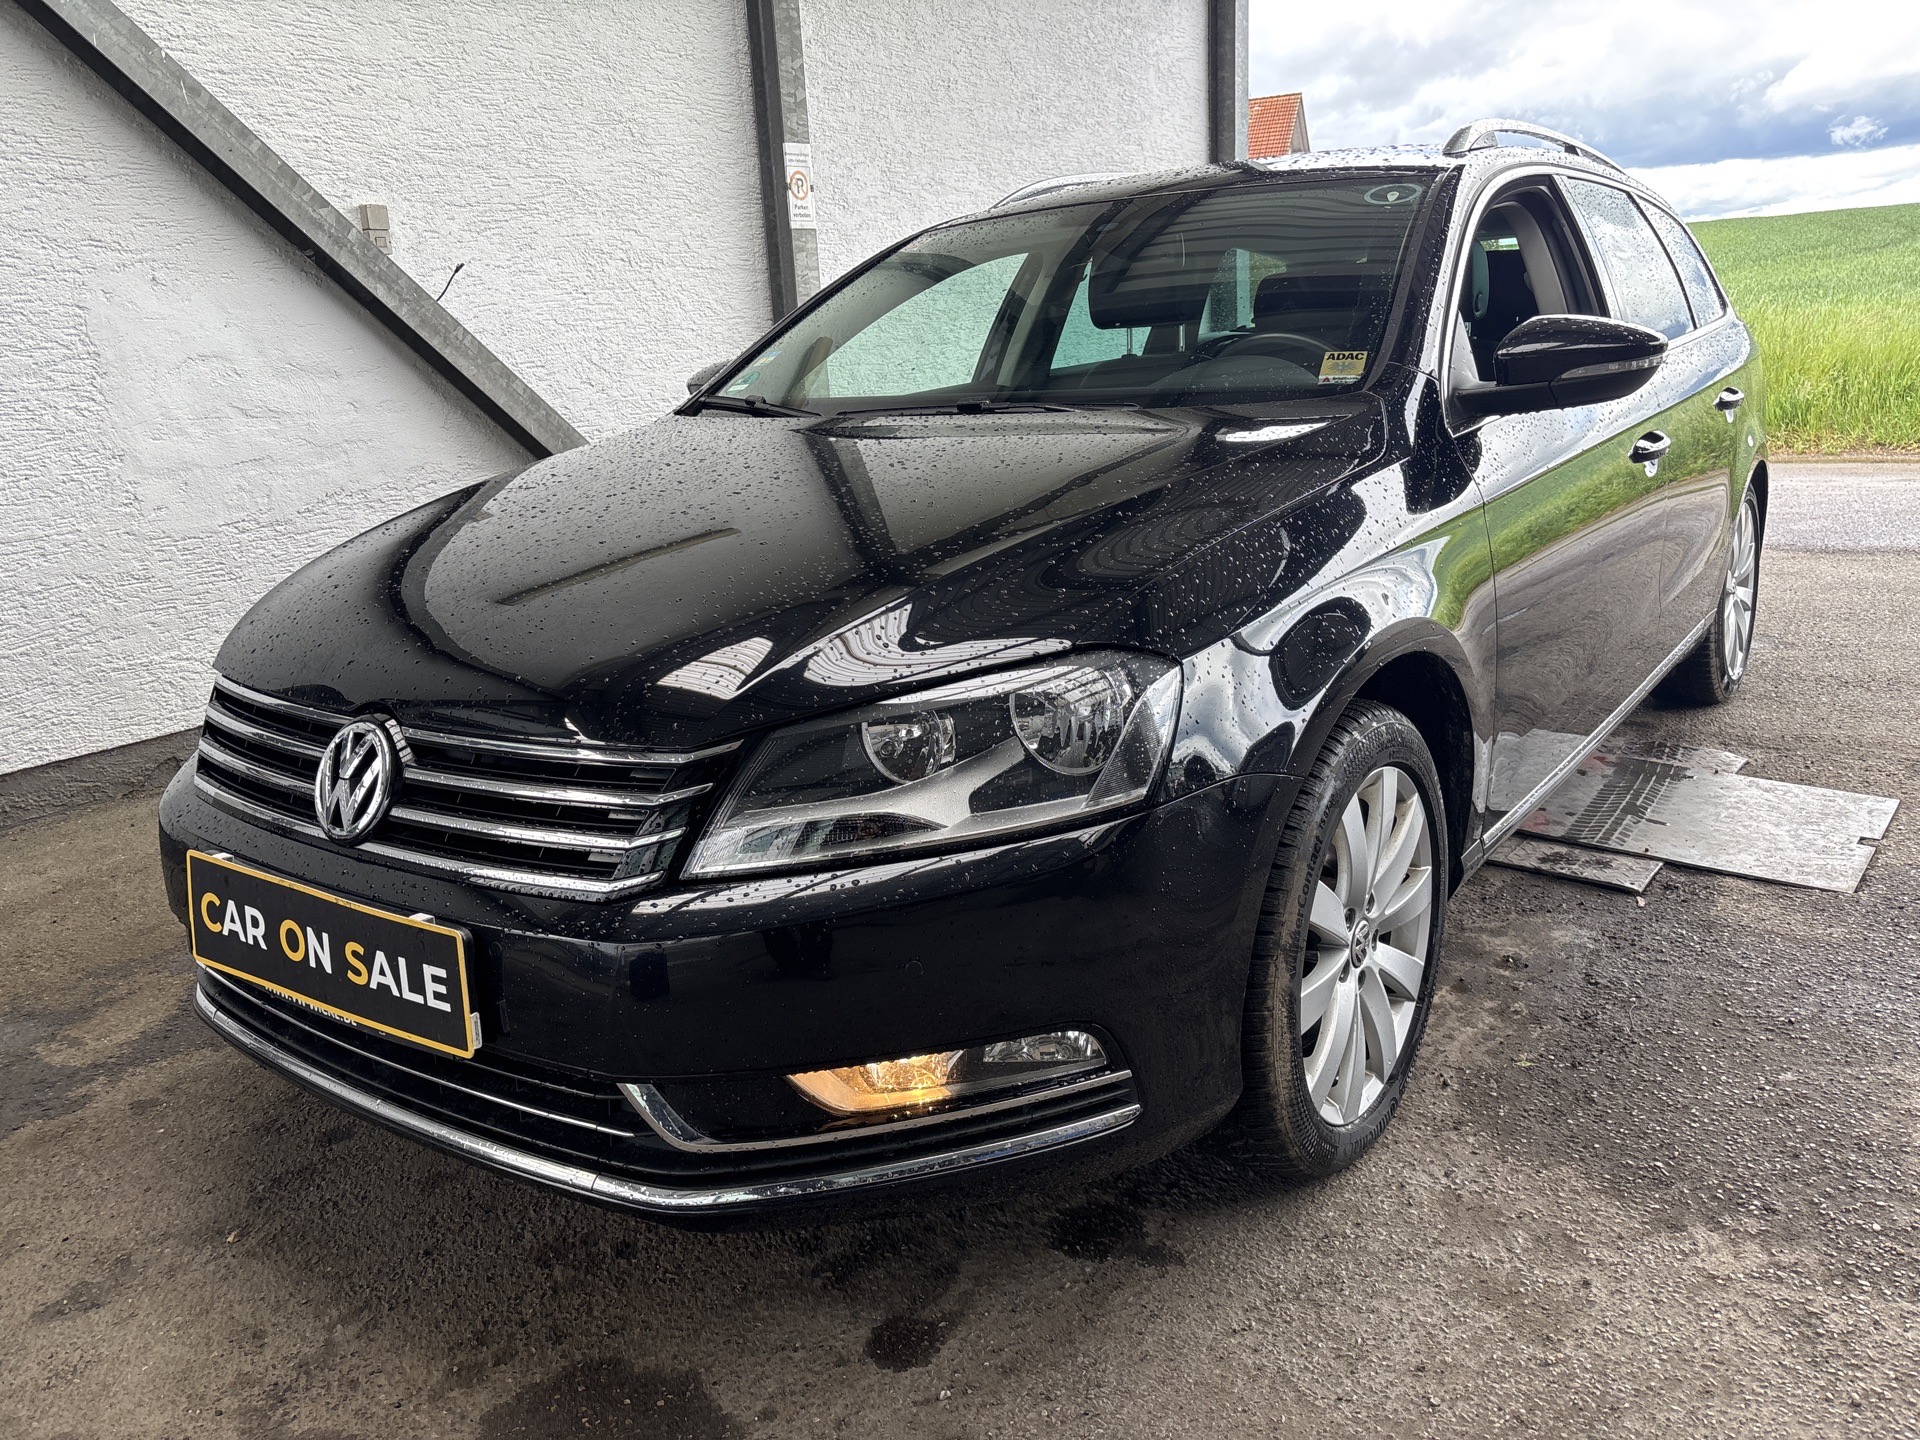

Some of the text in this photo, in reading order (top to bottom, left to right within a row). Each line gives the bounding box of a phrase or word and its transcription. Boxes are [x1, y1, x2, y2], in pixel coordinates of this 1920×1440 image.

[1326, 352, 1364, 361] ADAC
[201, 892, 452, 1013] CAR ON SALE
